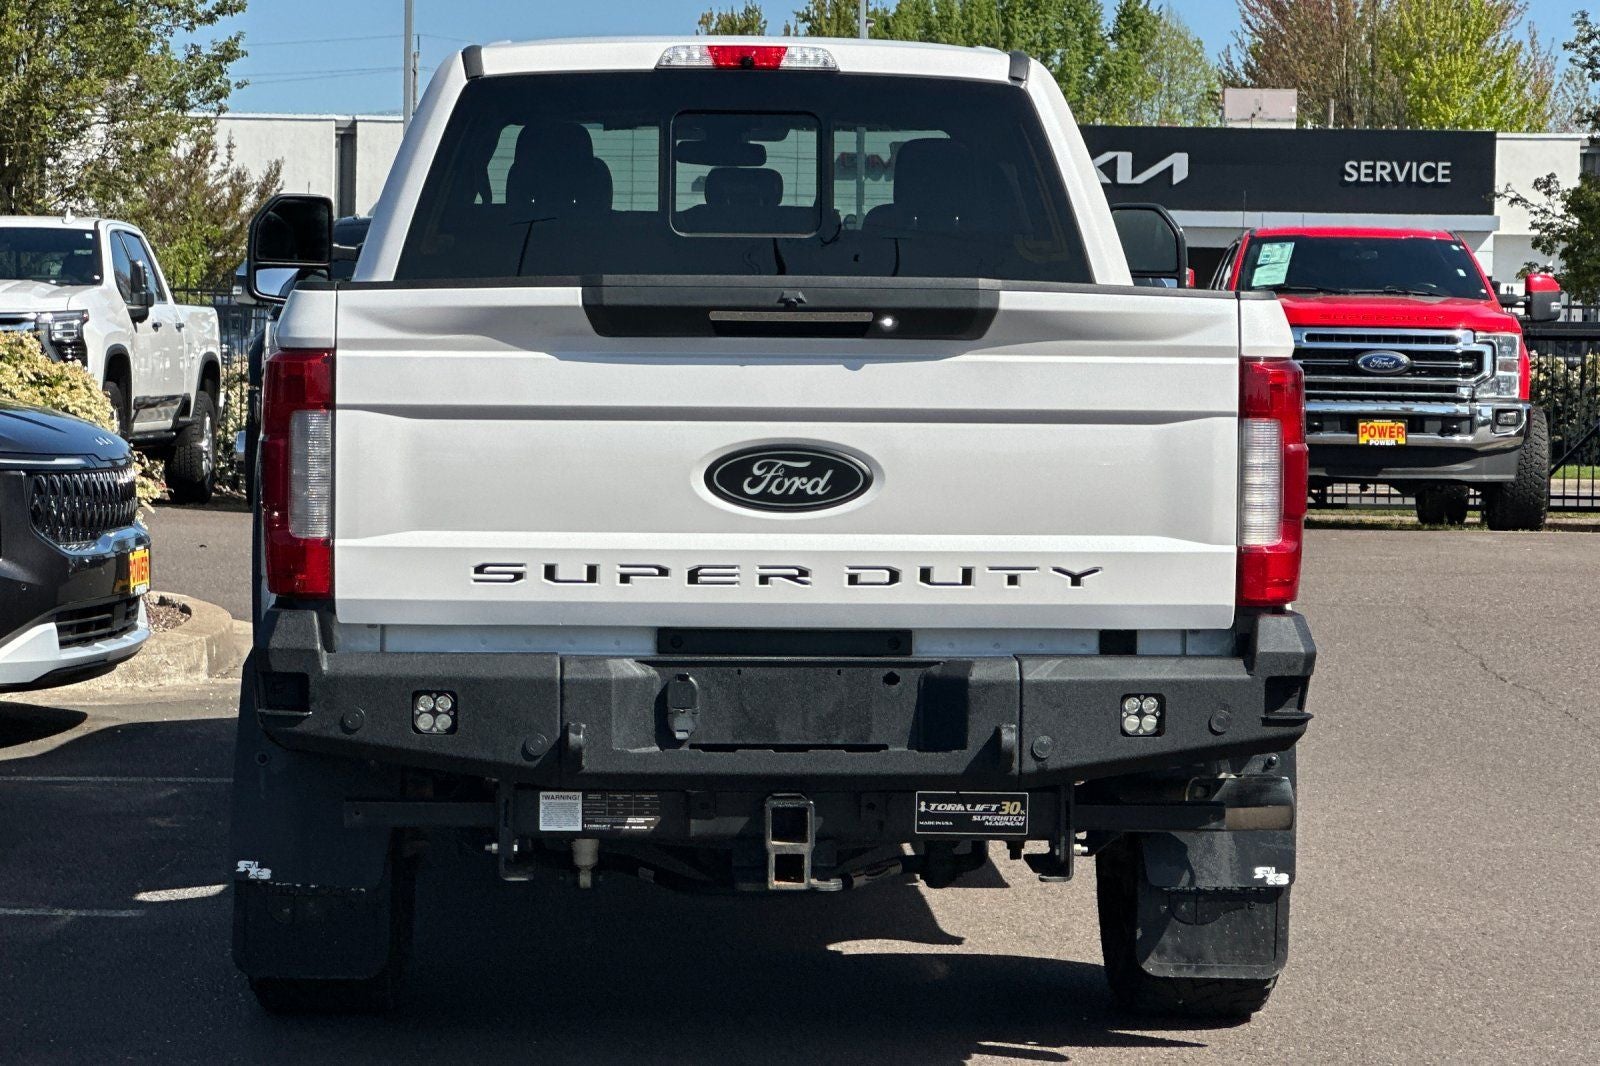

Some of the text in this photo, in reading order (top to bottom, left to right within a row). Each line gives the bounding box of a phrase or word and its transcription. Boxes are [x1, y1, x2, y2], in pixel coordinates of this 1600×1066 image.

[1343, 160, 1452, 184] SERVICE
[1369, 357, 1396, 369] Ford
[1360, 425, 1405, 438] POWER
[743, 458, 834, 496] Ford
[471, 562, 1103, 588] SUPER DUTY
